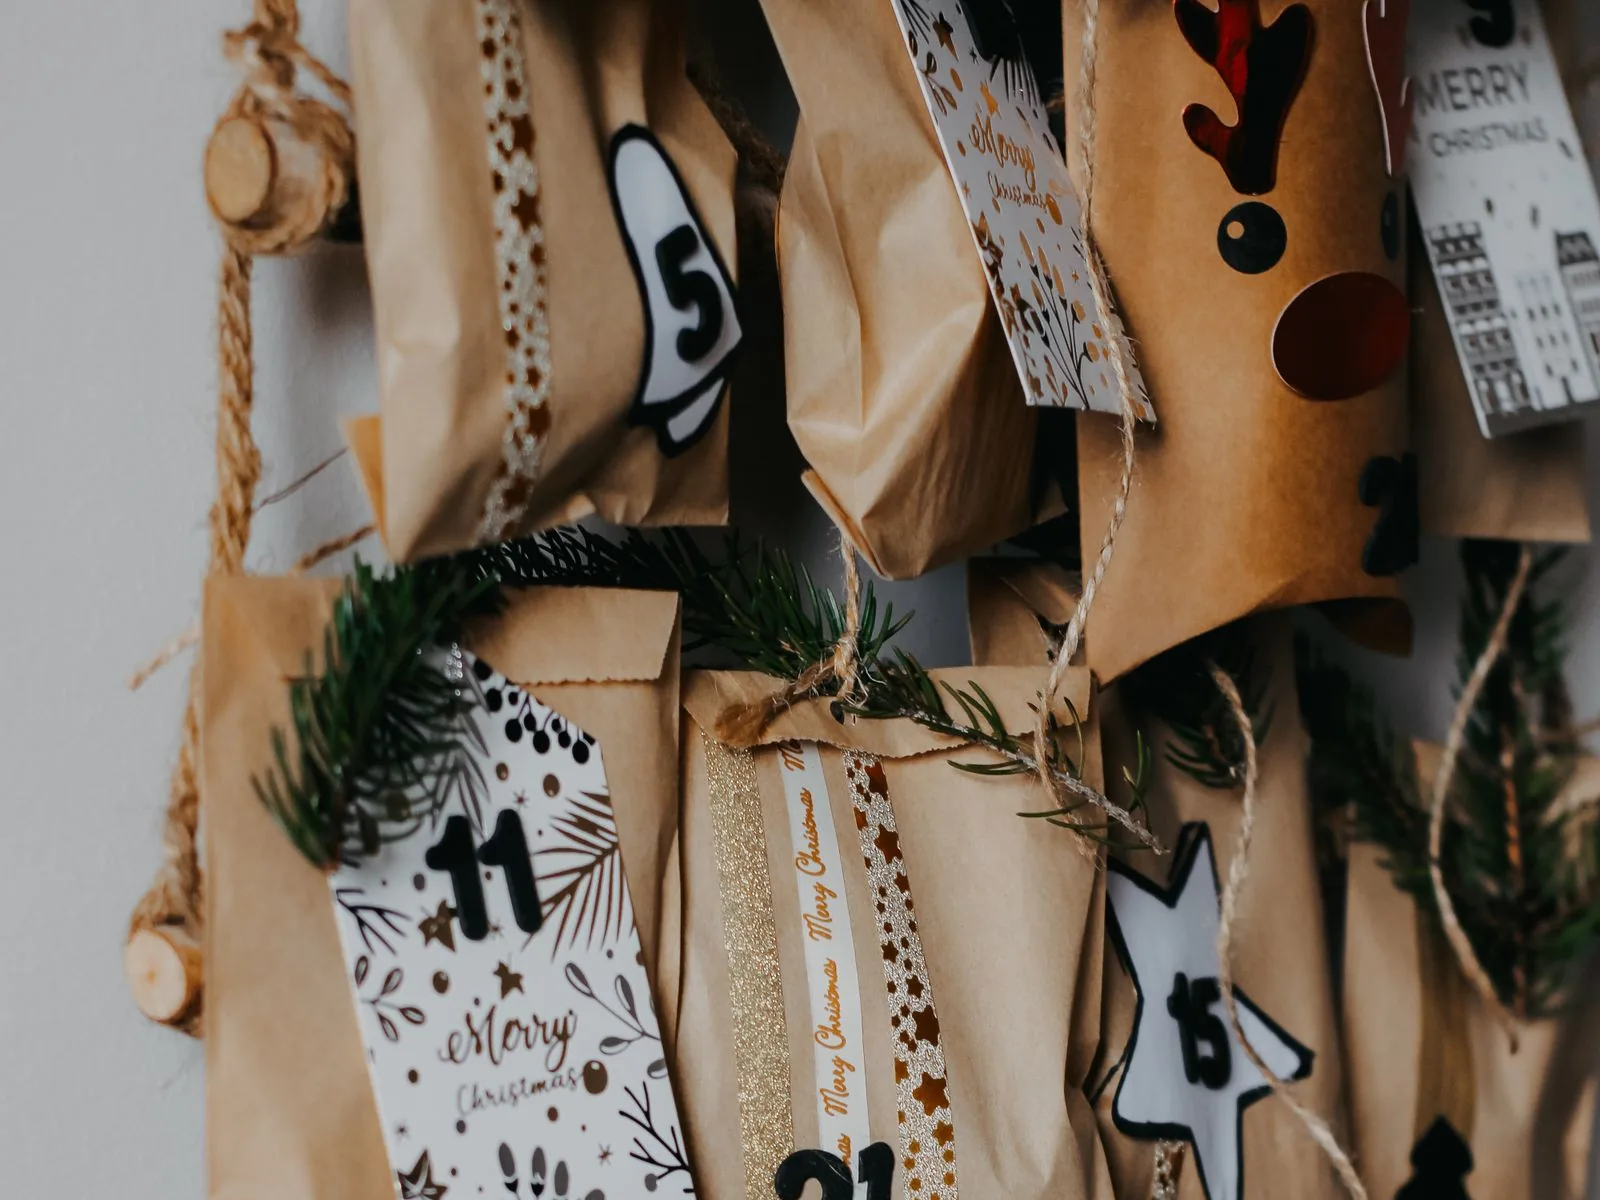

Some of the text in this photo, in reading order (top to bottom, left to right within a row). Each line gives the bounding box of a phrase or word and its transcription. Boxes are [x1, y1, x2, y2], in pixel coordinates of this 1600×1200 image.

[1415, 62, 1531, 117] MERRY
[968, 110, 1036, 193] Merry
[655, 223, 724, 364] 5
[795, 786, 827, 878] Christmas
[425, 808, 544, 942] 11
[802, 881, 838, 942] Merry
[437, 1003, 578, 1073] Merry
[814, 957, 847, 1050] Christmas
[1166, 970, 1233, 1091] 15
[456, 1065, 584, 1117] Christmas
[819, 1054, 856, 1117] Merry
